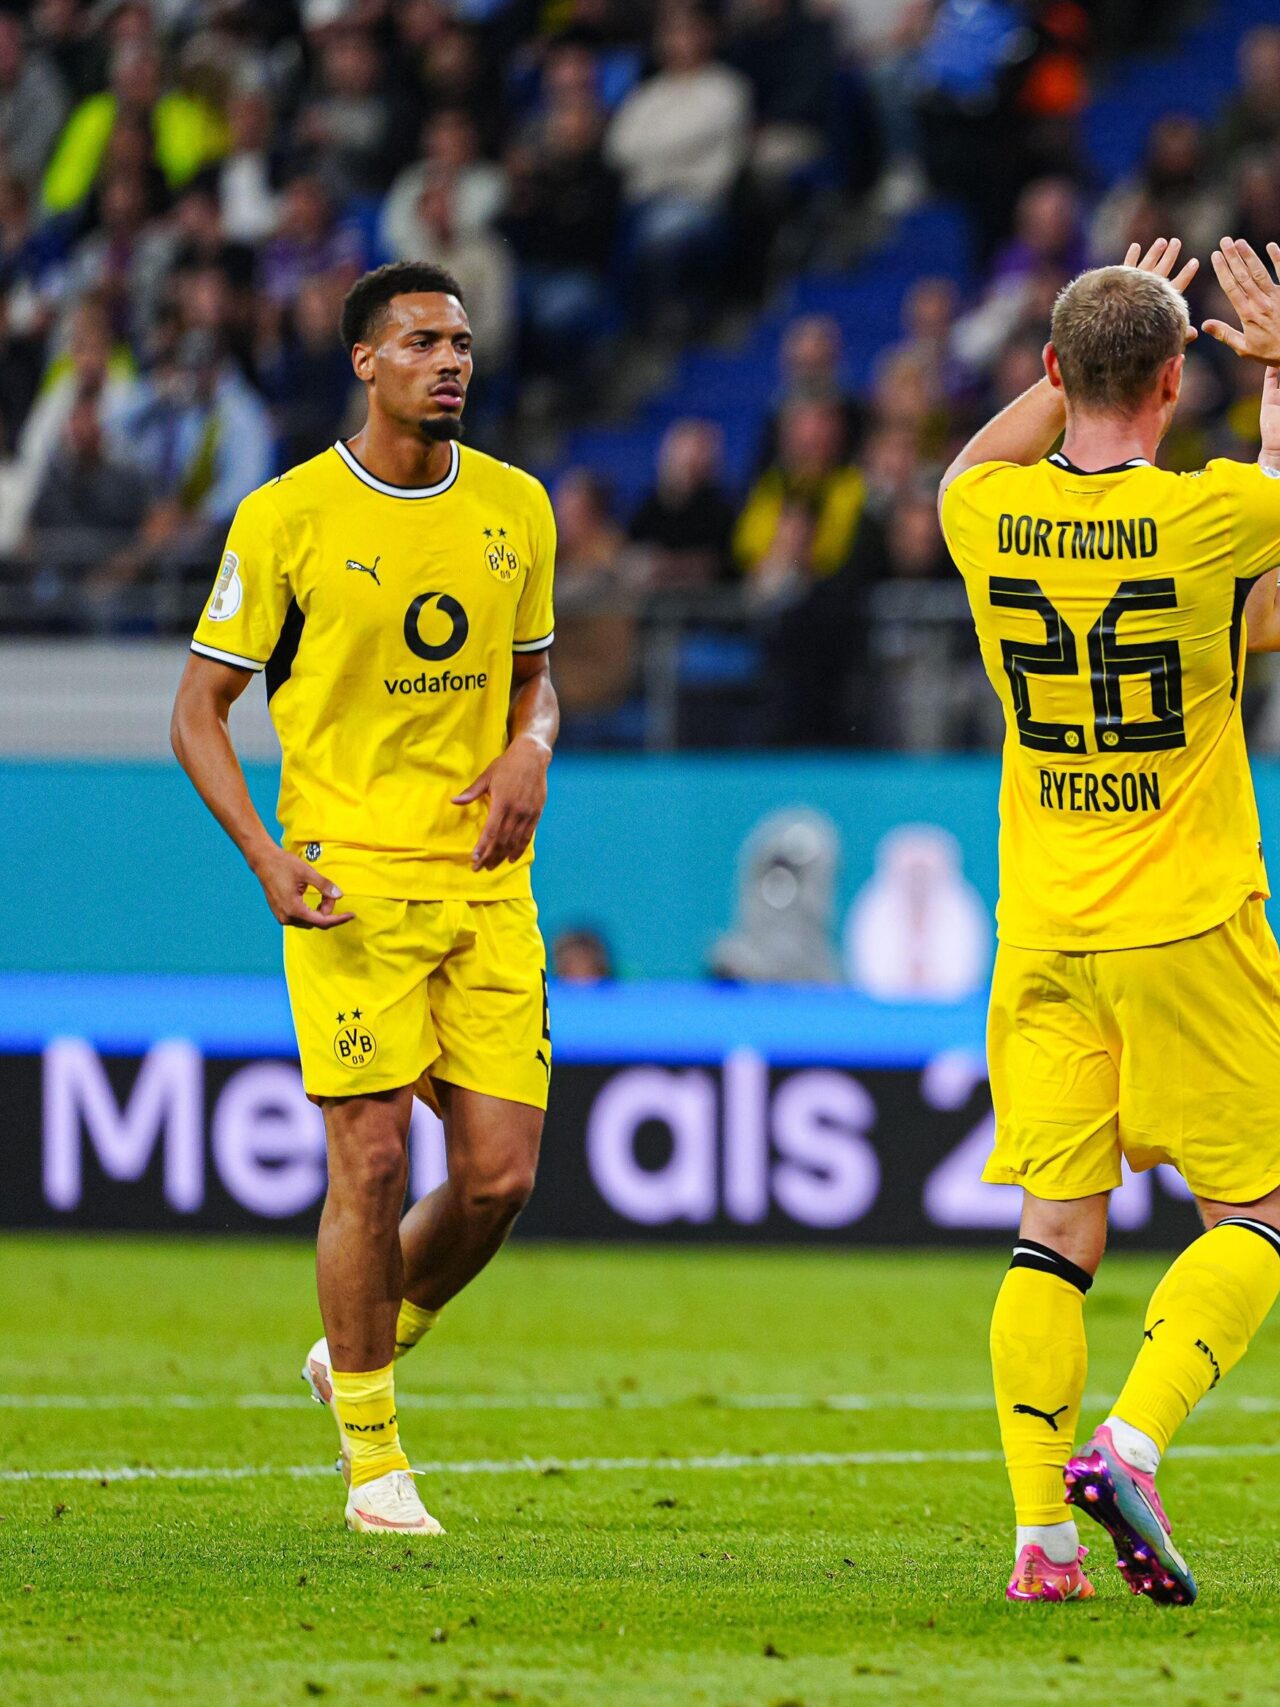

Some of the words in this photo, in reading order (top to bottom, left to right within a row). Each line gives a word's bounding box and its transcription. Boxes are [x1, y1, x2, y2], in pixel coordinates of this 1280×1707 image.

[997, 512, 1159, 560] DORTMUND
[488, 544, 517, 571] BVB
[384, 670, 488, 696] vodafone
[988, 575, 1187, 755] 26
[1039, 768, 1162, 813] RYERSON
[338, 1028, 373, 1057] BVB
[352, 1054, 365, 1065] 09
[586, 1048, 882, 1230] als
